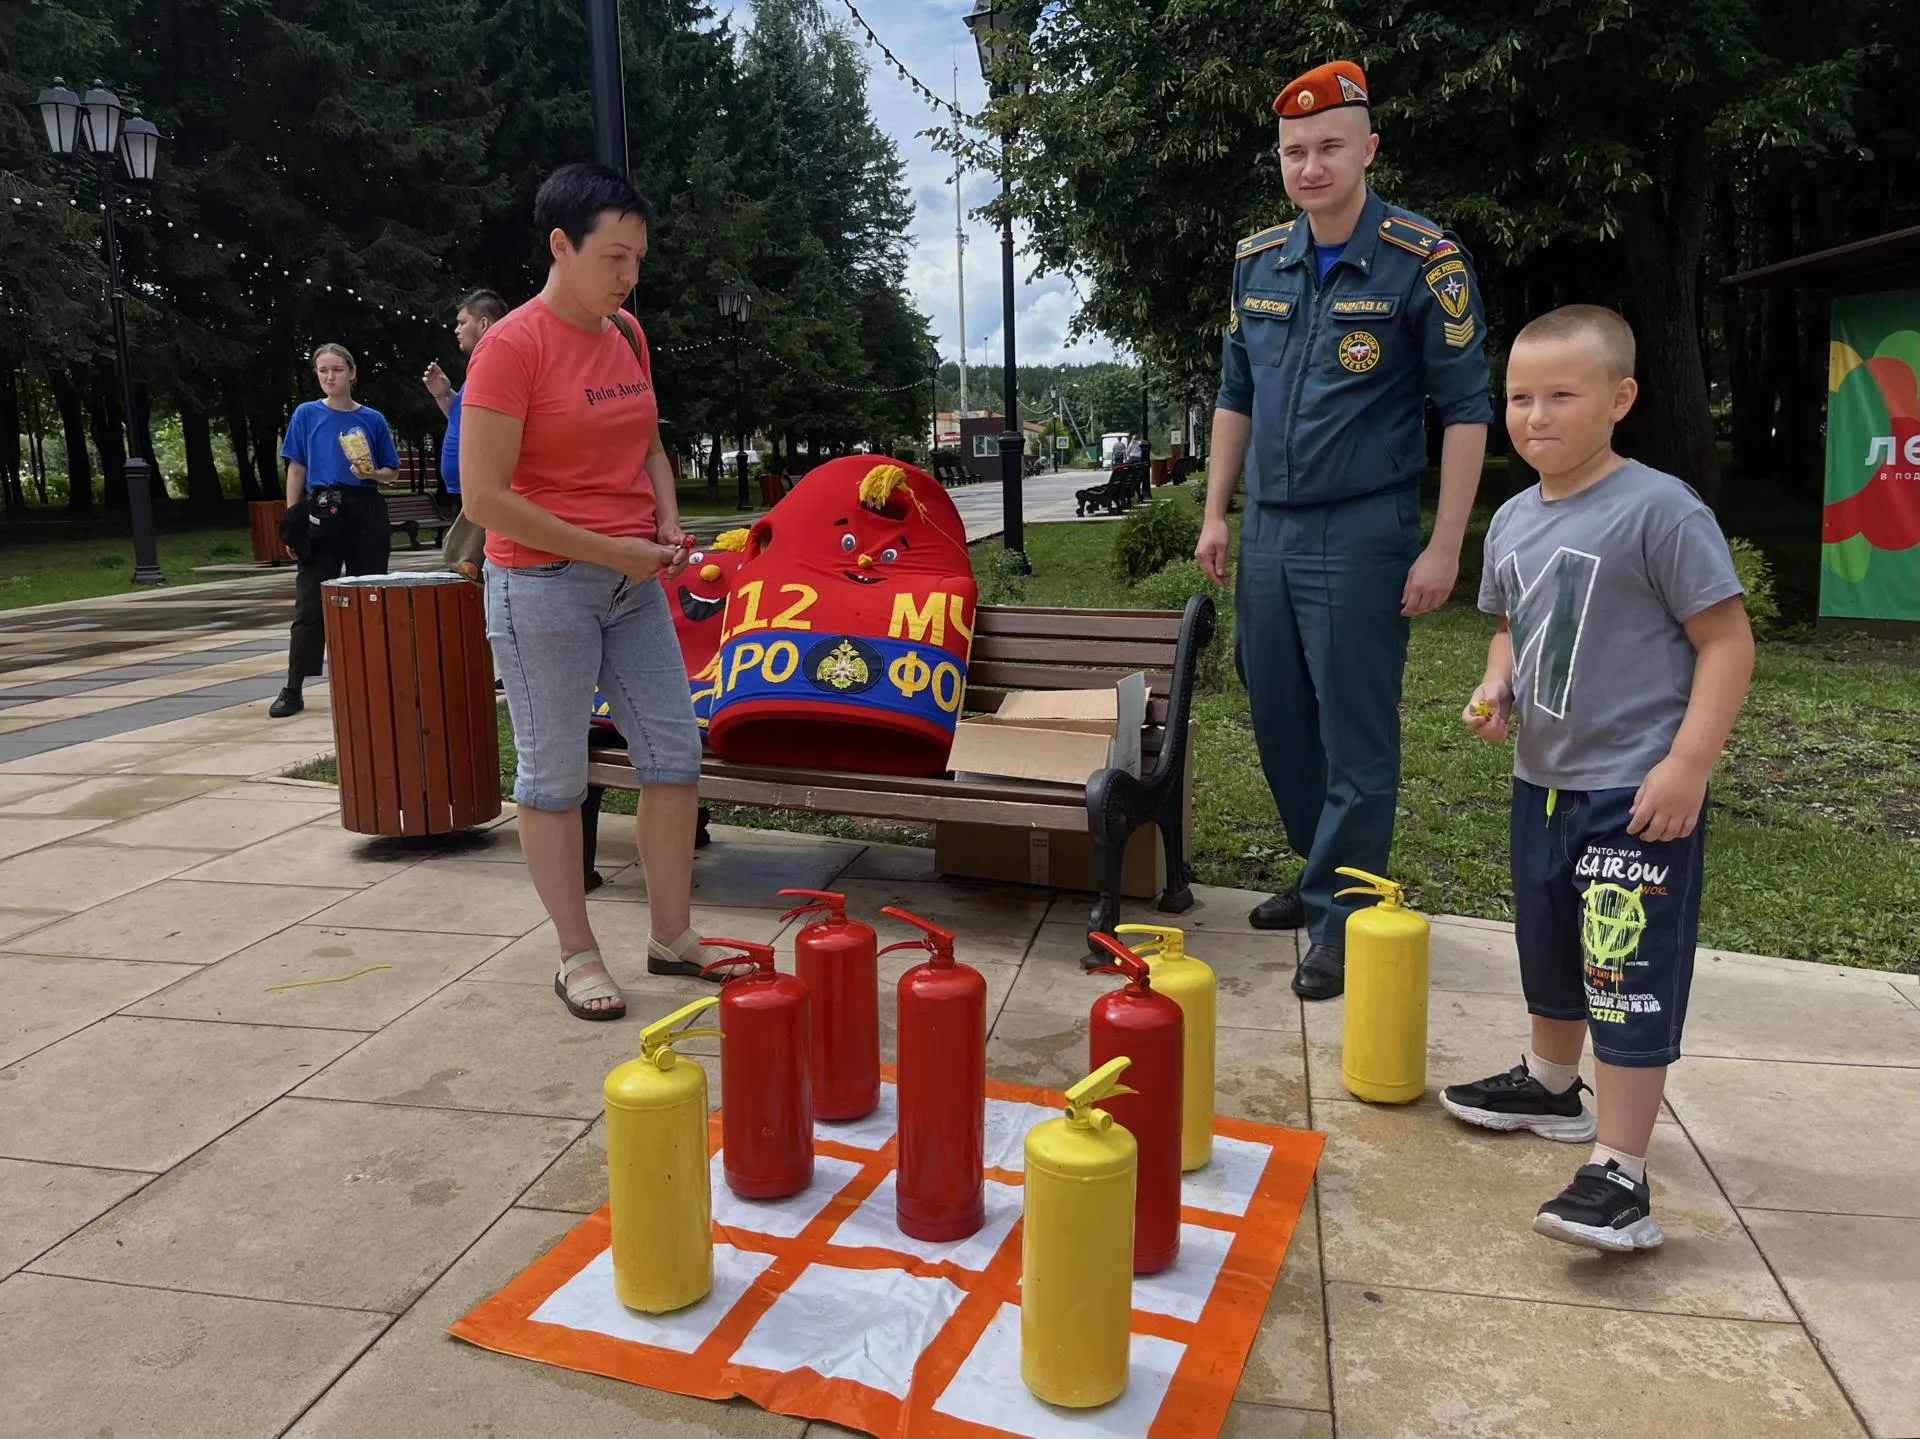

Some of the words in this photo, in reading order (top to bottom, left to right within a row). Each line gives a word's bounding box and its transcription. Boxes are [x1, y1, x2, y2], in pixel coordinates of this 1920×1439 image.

[1428, 269, 1442, 281] МЧС
[1244, 297, 1261, 308] МЧС
[1260, 300, 1288, 313] РОССИИ
[584, 387, 617, 406] Palm
[617, 381, 649, 397] Angels
[1628, 993, 1656, 1001] SCHOOL
